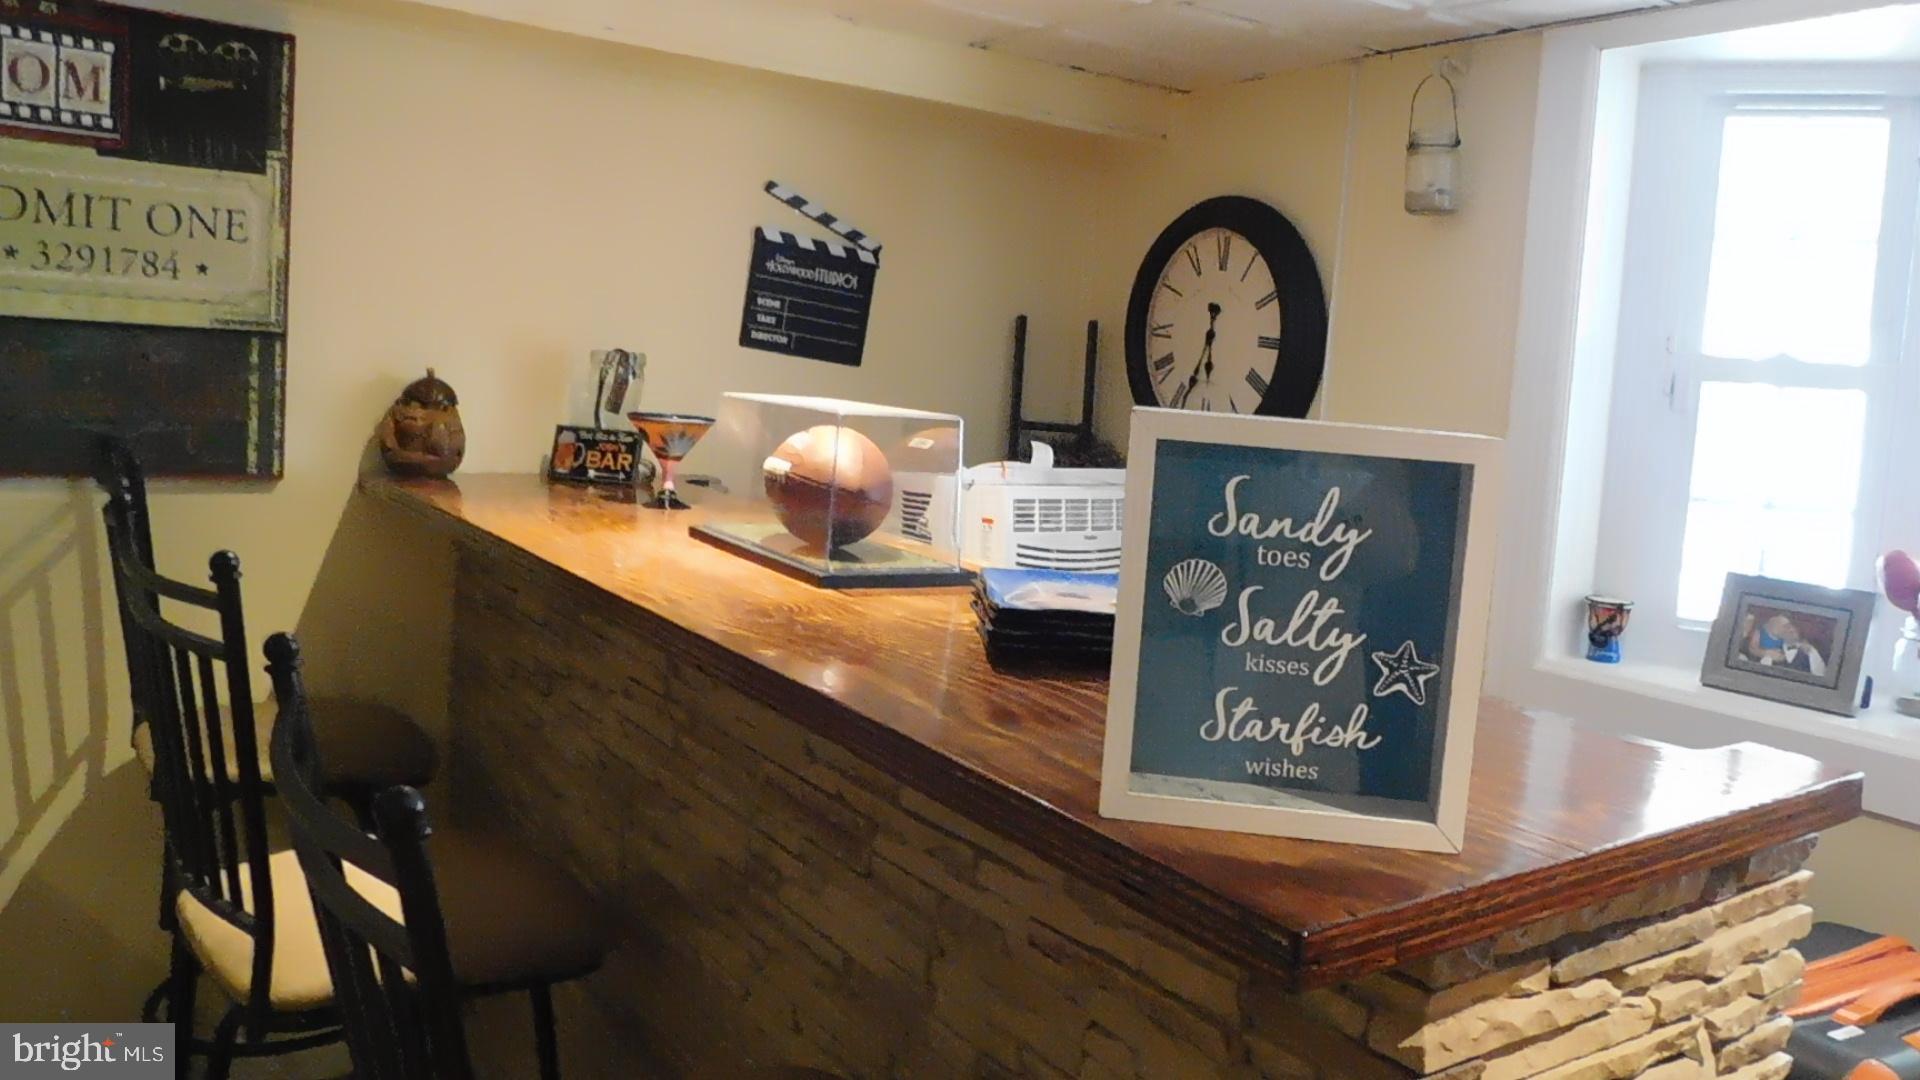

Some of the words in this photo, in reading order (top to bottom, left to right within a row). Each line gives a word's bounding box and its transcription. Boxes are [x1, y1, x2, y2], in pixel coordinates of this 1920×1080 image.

[146, 202, 249, 244] ONE
[30, 240, 181, 280] 3291784
[814, 267, 858, 290] STUDIOS
[756, 313, 777, 326] TAKE
[586, 449, 633, 472] BAR
[1208, 474, 1372, 581] Sandy
[1256, 545, 1311, 569] toes
[1221, 585, 1367, 687] Salty
[1245, 652, 1310, 676] kisses
[1200, 686, 1381, 756] Starfish
[1245, 757, 1319, 780] wishes
